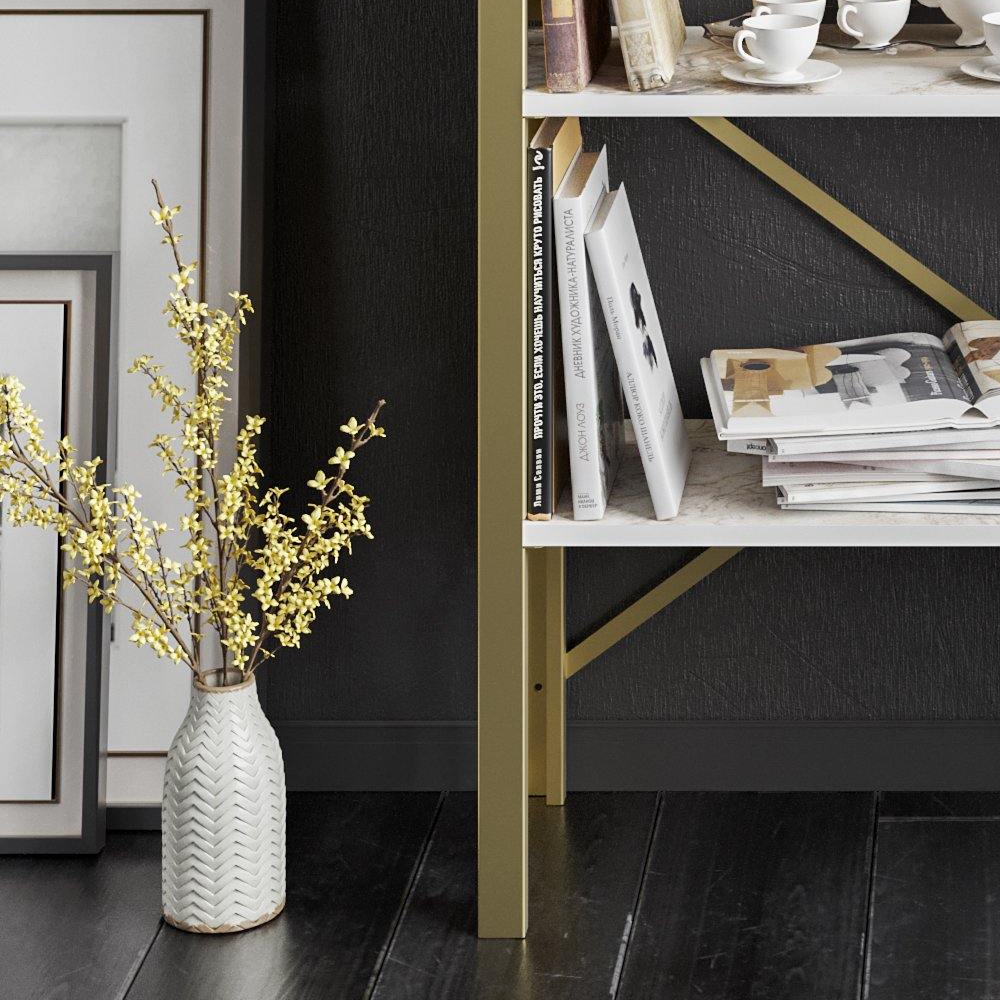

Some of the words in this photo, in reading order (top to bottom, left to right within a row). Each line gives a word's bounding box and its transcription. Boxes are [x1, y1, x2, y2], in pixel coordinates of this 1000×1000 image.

[533, 176, 543, 225] РИСОВАТЬ
[533, 225, 543, 258] КРУТО
[534, 258, 543, 313] НАУЧИТЬСЯ
[563, 208, 582, 336] ХУДОЖНИКА-НАТУРАЛИСТА
[534, 314, 543, 354] ХОЧЕШЬ
[534, 355, 543, 380] ЕСЛИ
[572, 338, 586, 380] ДНЕВНИК
[533, 380, 543, 401] ЭТО,
[533, 401, 543, 440] ПРОЧТИ
[576, 402, 586, 429] ЛОУЗ
[578, 429, 590, 462] ДЖОН
